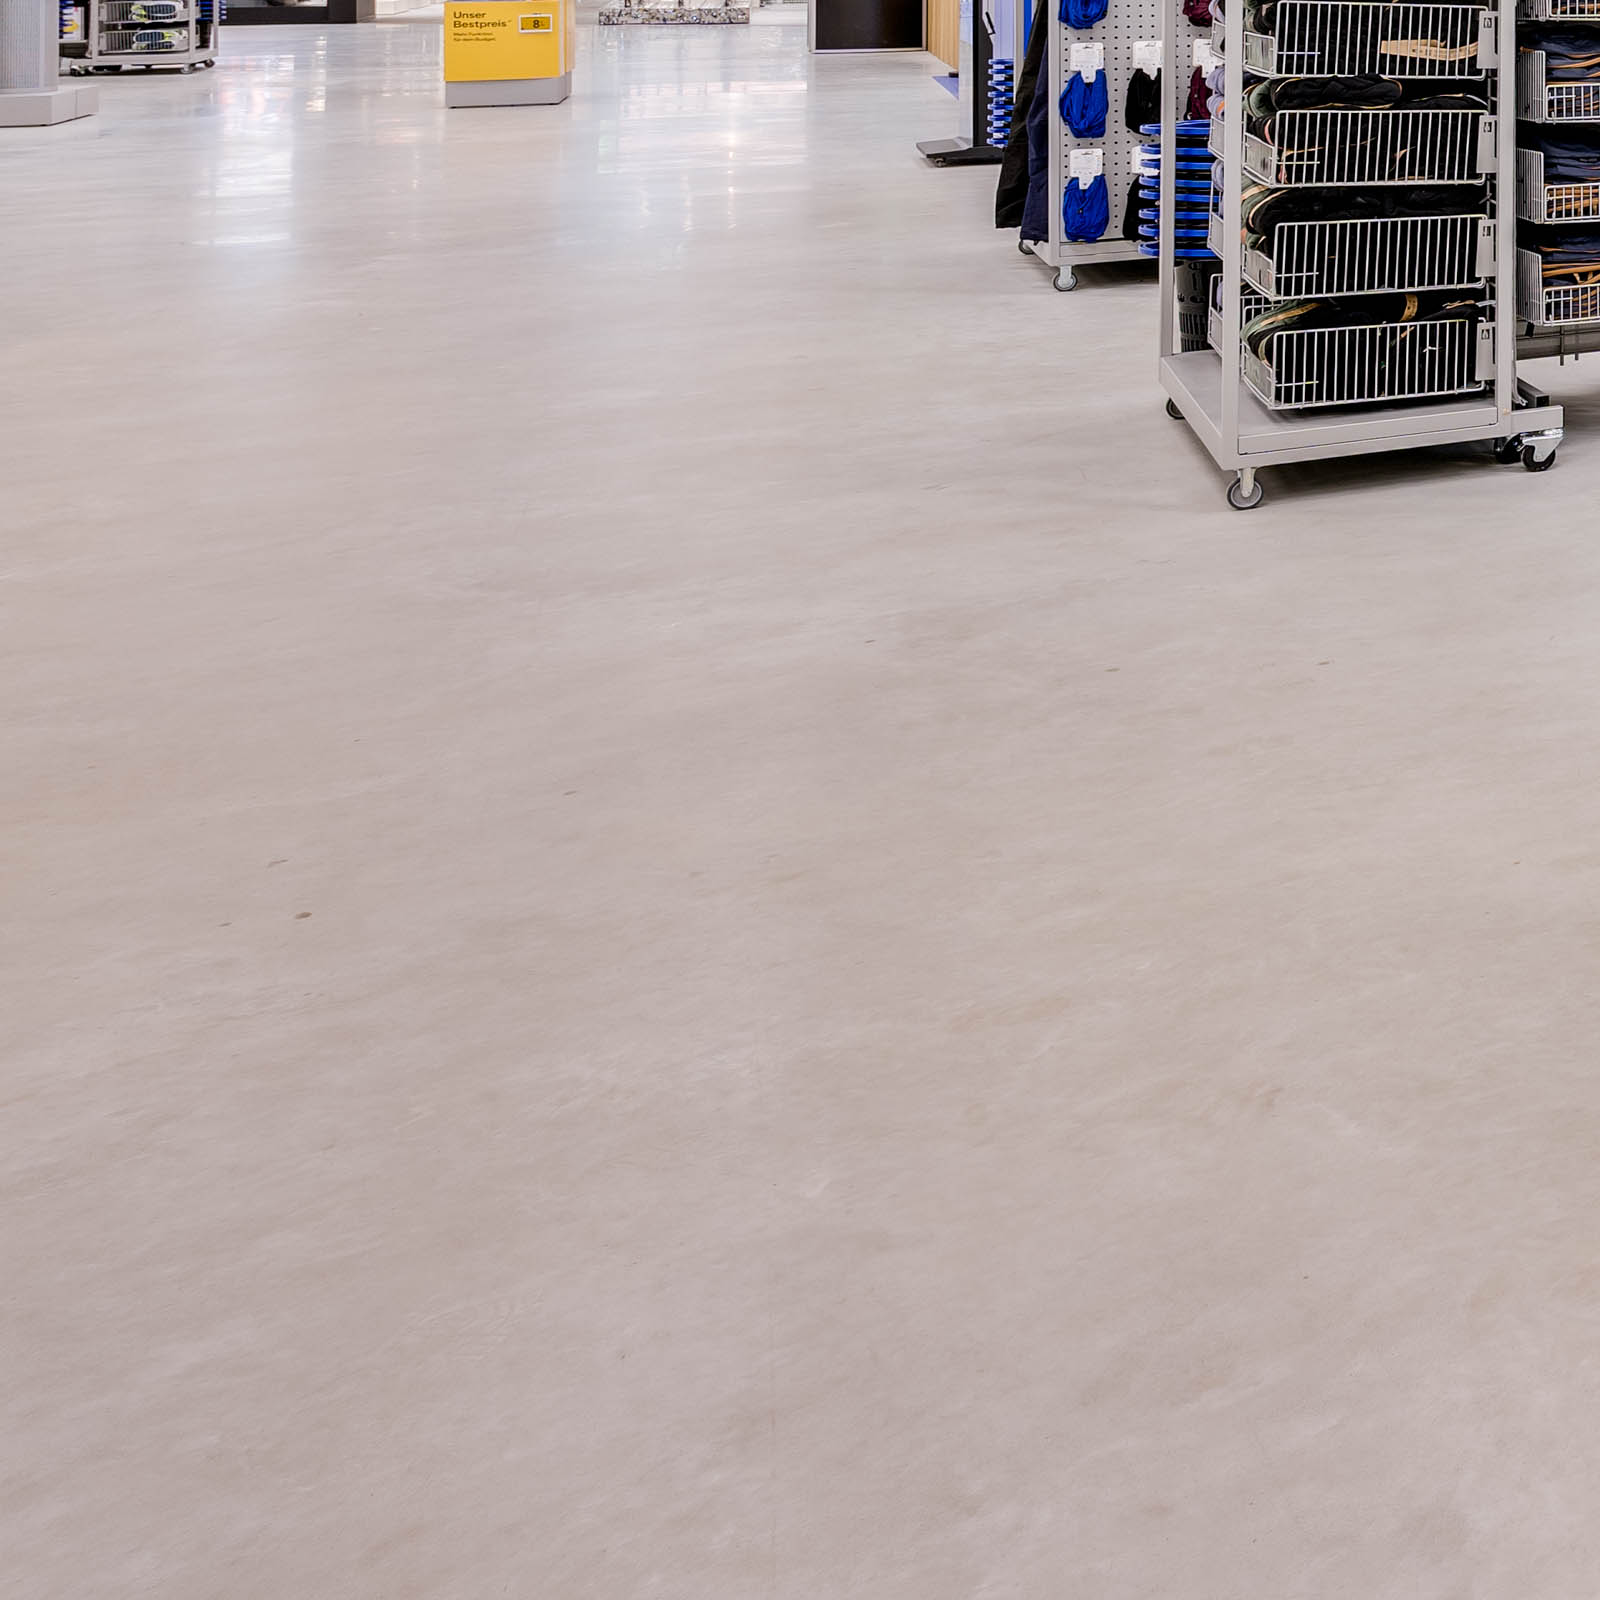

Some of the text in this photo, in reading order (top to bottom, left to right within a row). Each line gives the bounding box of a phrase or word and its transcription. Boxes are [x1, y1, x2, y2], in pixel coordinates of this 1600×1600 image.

[453, 11, 487, 19] Unser
[453, 20, 507, 29] Bestpreis
[532, 19, 540, 29] 8
